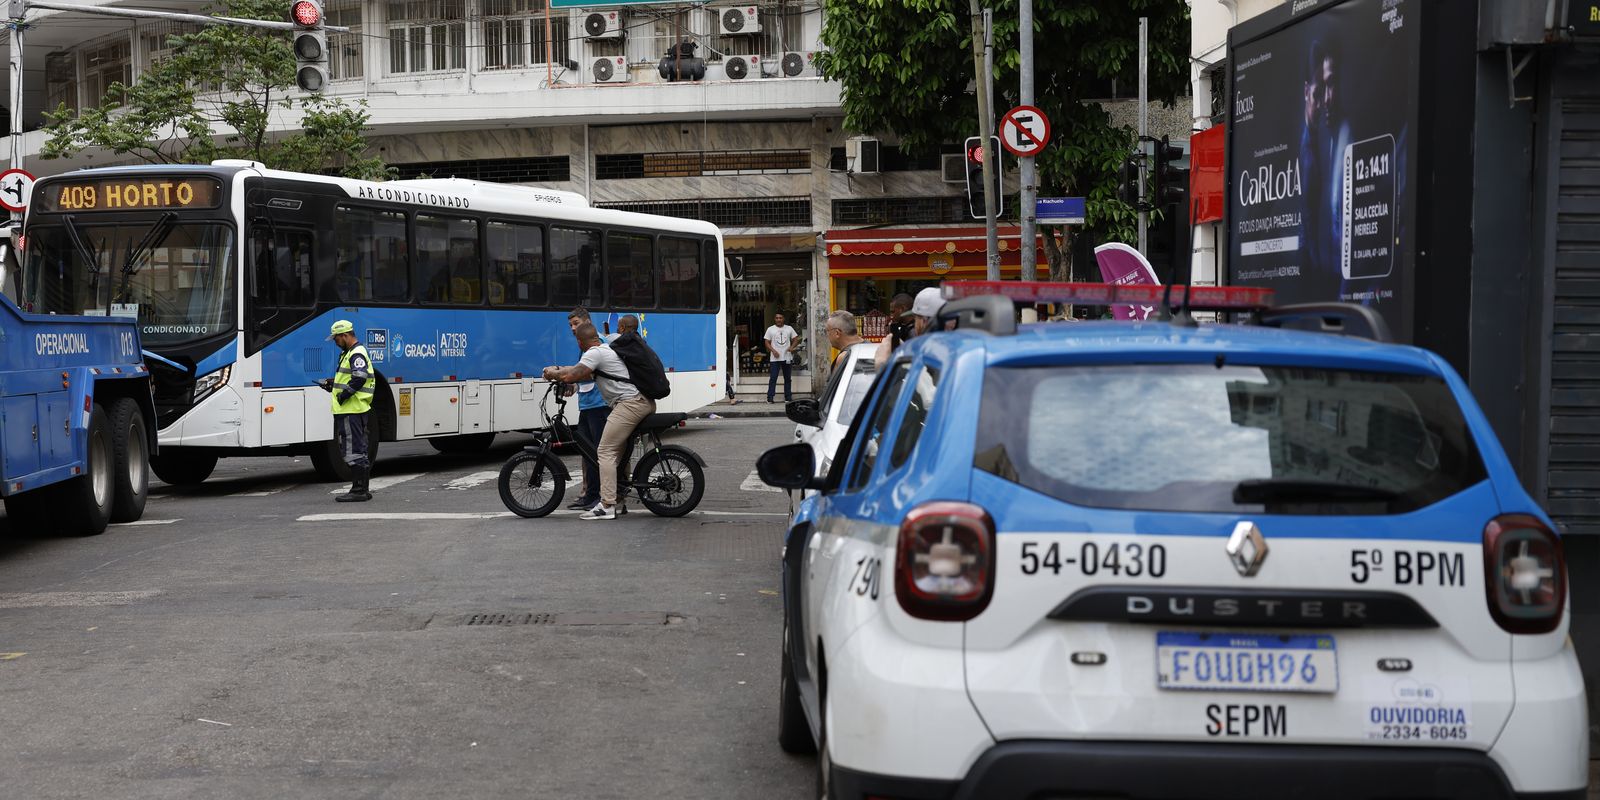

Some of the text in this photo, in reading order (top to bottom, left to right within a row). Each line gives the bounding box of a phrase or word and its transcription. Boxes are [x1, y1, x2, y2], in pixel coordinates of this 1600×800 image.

[1236, 91, 1254, 115] focus
[1016, 116, 1034, 146] E
[1356, 153, 1389, 180] 12 a 14.11
[60, 182, 193, 209] 409 HORTO
[359, 186, 470, 209] AR CONDICIONADO
[1354, 206, 1368, 220] SALA
[1239, 219, 1255, 234] FOCUS
[1255, 216, 1273, 232] DANÇA
[1354, 221, 1378, 236] MEIRELES
[143, 325, 207, 334] CONDICIONADO
[374, 333, 385, 343] Rio
[35, 333, 89, 355] OPERACIONAL
[120, 332, 134, 356] 013
[440, 333, 467, 349] A71518
[369, 350, 384, 361] 1746
[404, 344, 436, 359] GRAÇAS
[441, 348, 466, 357] INTERSUL
[1021, 542, 1166, 578] 54-0430
[1351, 549, 1465, 587] 5º BPM
[848, 555, 881, 601] 190
[1126, 596, 1367, 619] DUSTER
[1230, 639, 1258, 647] BRASIL
[1206, 704, 1287, 737] SEPM
[1370, 707, 1466, 725] OUVIDORIA
[1383, 725, 1467, 740] 2334-6045
